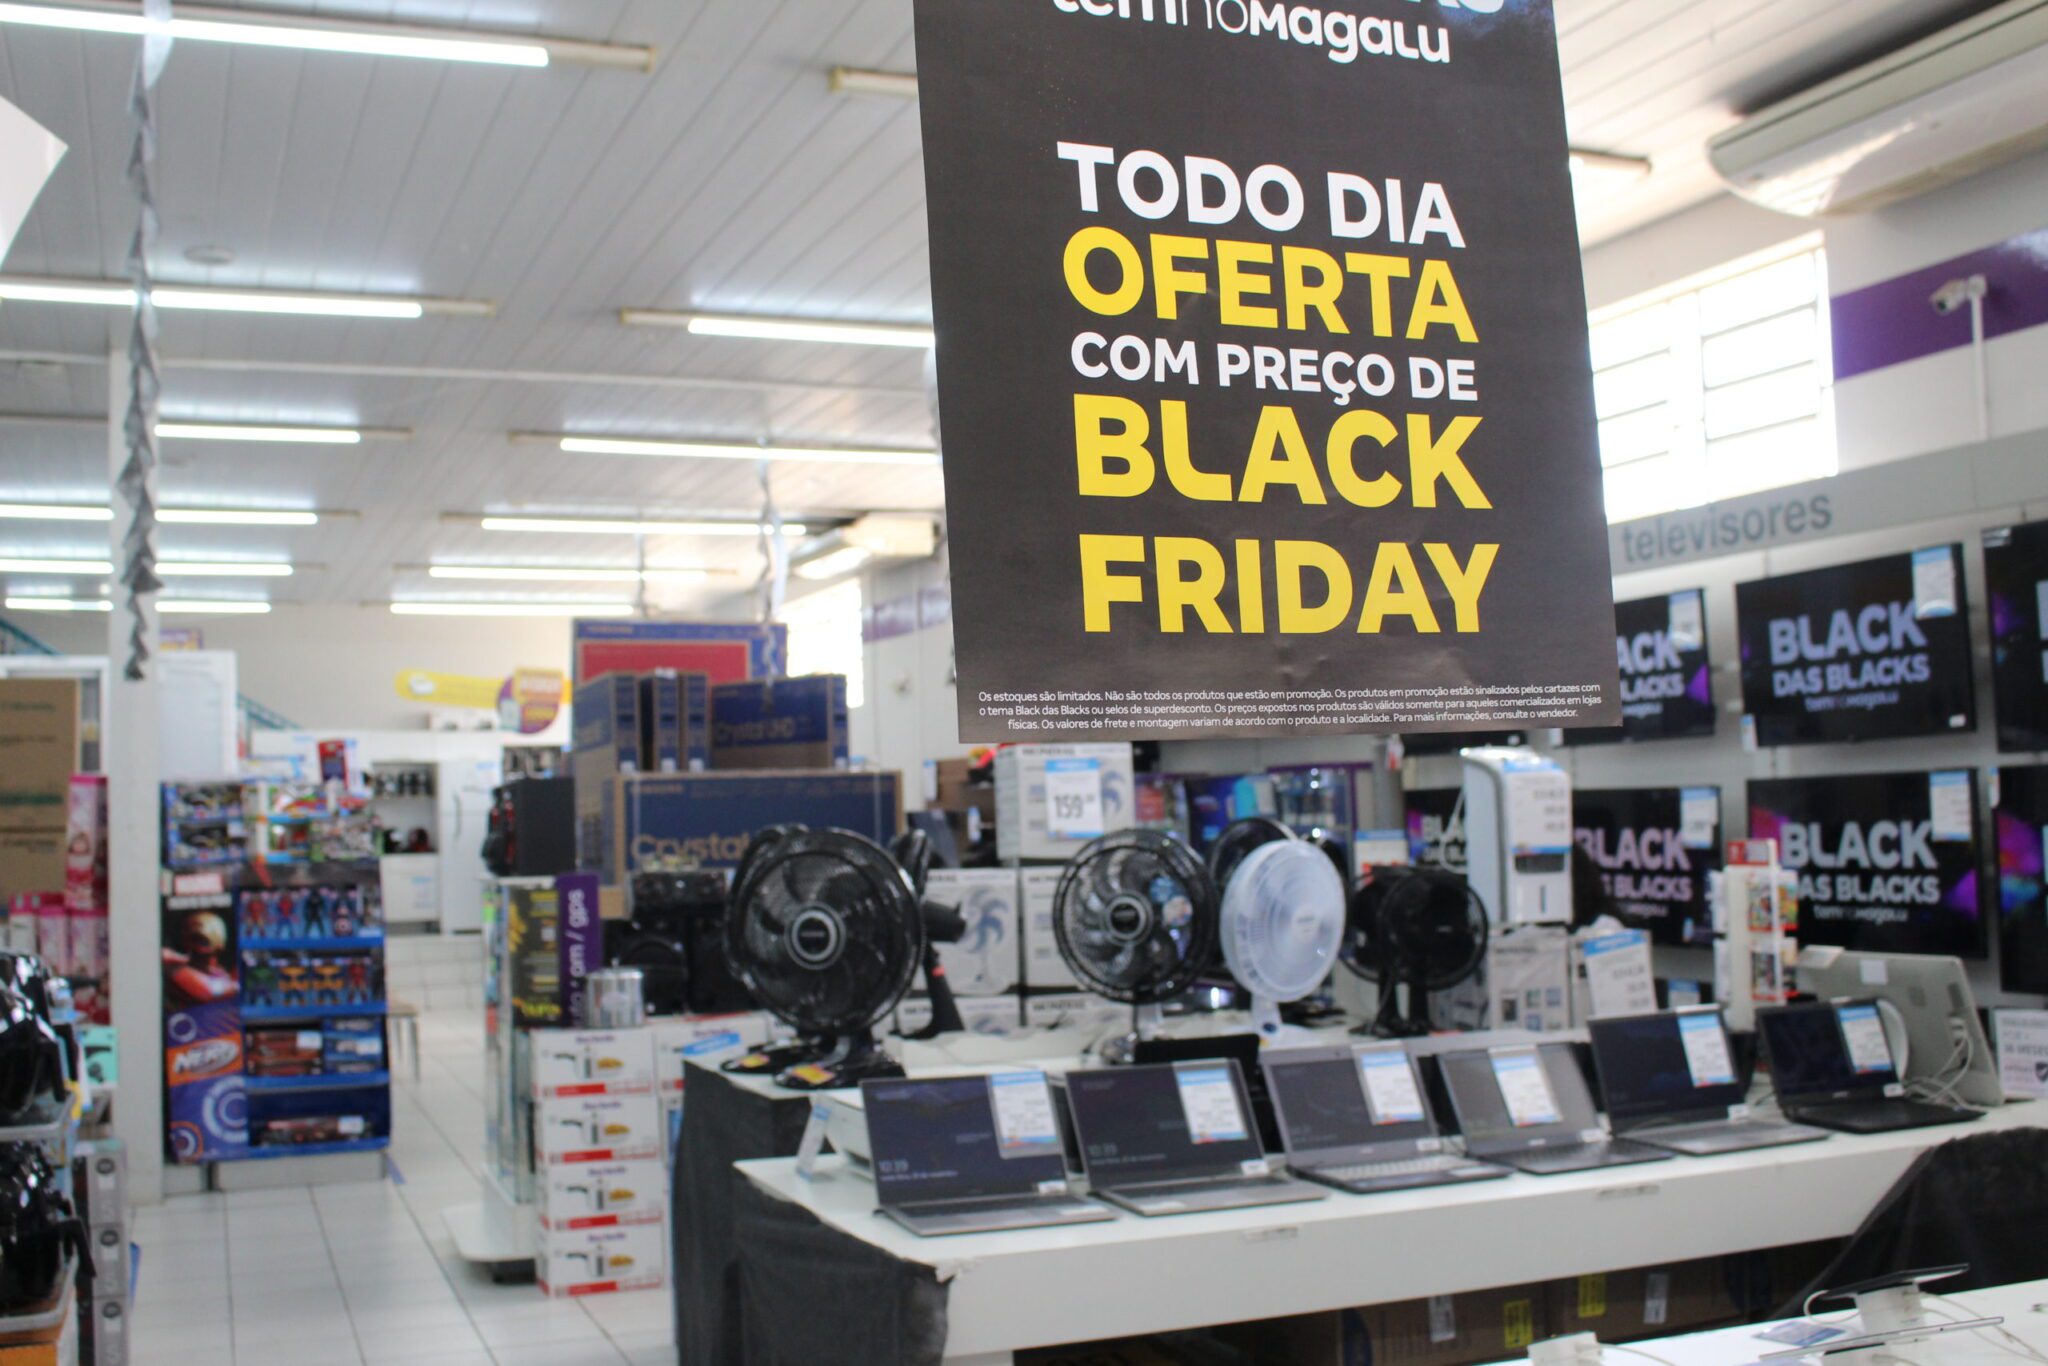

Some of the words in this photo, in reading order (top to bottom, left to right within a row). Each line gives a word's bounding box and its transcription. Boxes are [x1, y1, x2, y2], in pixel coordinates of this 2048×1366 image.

[1057, 141, 1304, 231] TODO
[1327, 172, 1466, 248] DIA
[1063, 227, 1479, 343] OFERTA
[1071, 332, 1199, 384] COM
[1217, 343, 1395, 405] PREÇO
[1409, 357, 1478, 402] DE
[1074, 394, 1492, 509] BLACK
[1621, 495, 1833, 563] televisores
[1080, 534, 1499, 634] FRIDAY
[1768, 600, 1928, 666] BLACK
[979, 691, 992, 701] Os
[993, 691, 1038, 704] estoques
[1039, 690, 1056, 700] são
[1057, 690, 1103, 700] limitados.
[1105, 690, 1124, 700] Não
[1125, 690, 1142, 700] são
[1143, 690, 1171, 700] todos
[1172, 692, 1183, 700] os
[1184, 689, 1225, 702] produtos
[1226, 691, 1243, 702] que
[1245, 689, 1269, 699] estão
[1270, 691, 1285, 699] em
[1286, 688, 1333, 701] promoção.
[1335, 688, 1347, 698] Os
[1348, 688, 1388, 701] produtos
[1389, 689, 1403, 697] em
[1405, 686, 1449, 699] promoção
[1450, 686, 1474, 696] estão
[1475, 685, 1520, 695] sinalizados
[1521, 684, 1543, 697] pelos
[1544, 683, 1580, 693] cartazes
[1581, 685, 1600, 693] com
[1620, 673, 1685, 699] LACKS
[1772, 667, 1823, 697] DAS
[1827, 653, 1931, 690] BLACKS
[979, 708, 986, 716] o
[987, 706, 1014, 716] tema
[1015, 705, 1040, 715] Black
[1042, 705, 1059, 715] das
[1060, 705, 1090, 715] Blacks
[1091, 707, 1104, 715] ou
[1105, 704, 1129, 714] selos
[1130, 704, 1142, 714] de
[1144, 703, 1213, 716] superdesconto.
[1214, 703, 1227, 713] Os
[1228, 704, 1257, 715] preços
[1258, 702, 1298, 715] expostos
[1299, 703, 1315, 711] nos
[1316, 701, 1357, 714] produtos
[1358, 700, 1374, 710] são
[1375, 700, 1404, 710] válidos
[1405, 699, 1444, 709] somente
[1445, 700, 1465, 711] para
[1466, 697, 1499, 710] aqueles
[1500, 696, 1566, 706] comercializados
[1567, 697, 1581, 705] em
[1582, 695, 1602, 708] lojas
[1008, 719, 1040, 729] físicas.
[1041, 718, 1055, 728] Os
[1056, 718, 1089, 728] valores
[1090, 718, 1103, 728] de
[1104, 717, 1128, 727] frete
[1129, 719, 1135, 727] e
[1137, 717, 1188, 730] montagem
[1190, 716, 1221, 726] variam
[1222, 716, 1234, 726] de
[1235, 715, 1265, 725] acordo
[1267, 717, 1286, 725] com
[1287, 716, 1293, 724] o
[1295, 714, 1331, 727] produto
[1332, 715, 1338, 723] e
[1340, 715, 1345, 723] a
[1346, 712, 1392, 722] localidade.
[1393, 711, 1413, 721] Para
[1414, 711, 1435, 721] mais
[1436, 710, 1491, 723] informações,
[1493, 709, 1528, 719] consulte
[1529, 710, 1535, 718] o
[1536, 708, 1578, 718] vendedor.
[1781, 819, 1937, 869] BLACK
[567, 888, 590, 928] gps
[1614, 874, 1693, 901] BLACKS
[1836, 873, 1940, 902] BLACKS
